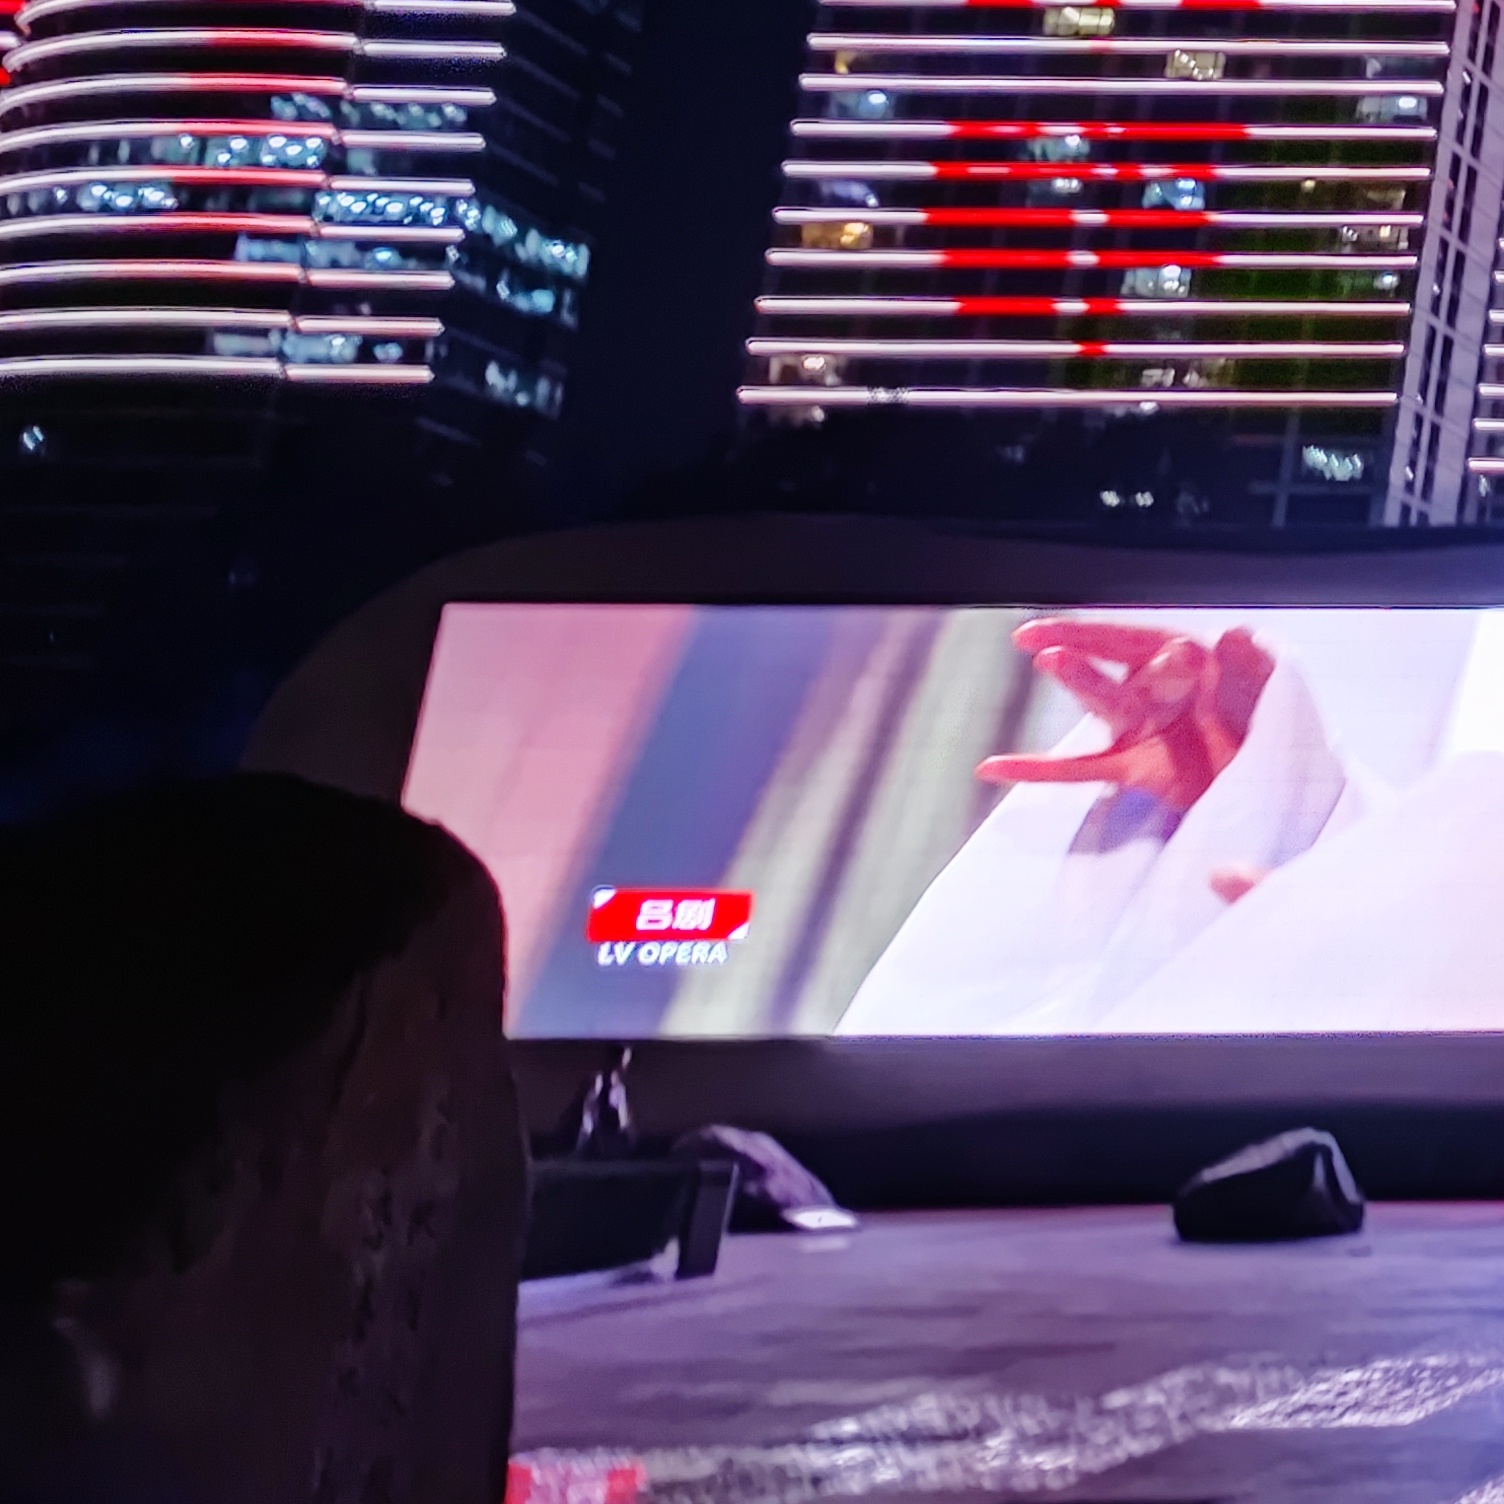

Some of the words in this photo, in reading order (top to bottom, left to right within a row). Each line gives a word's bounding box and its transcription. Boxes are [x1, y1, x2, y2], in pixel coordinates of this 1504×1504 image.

[635, 897, 717, 931] 吕剧
[597, 941, 635, 966] LV
[638, 941, 728, 966] OPERA
